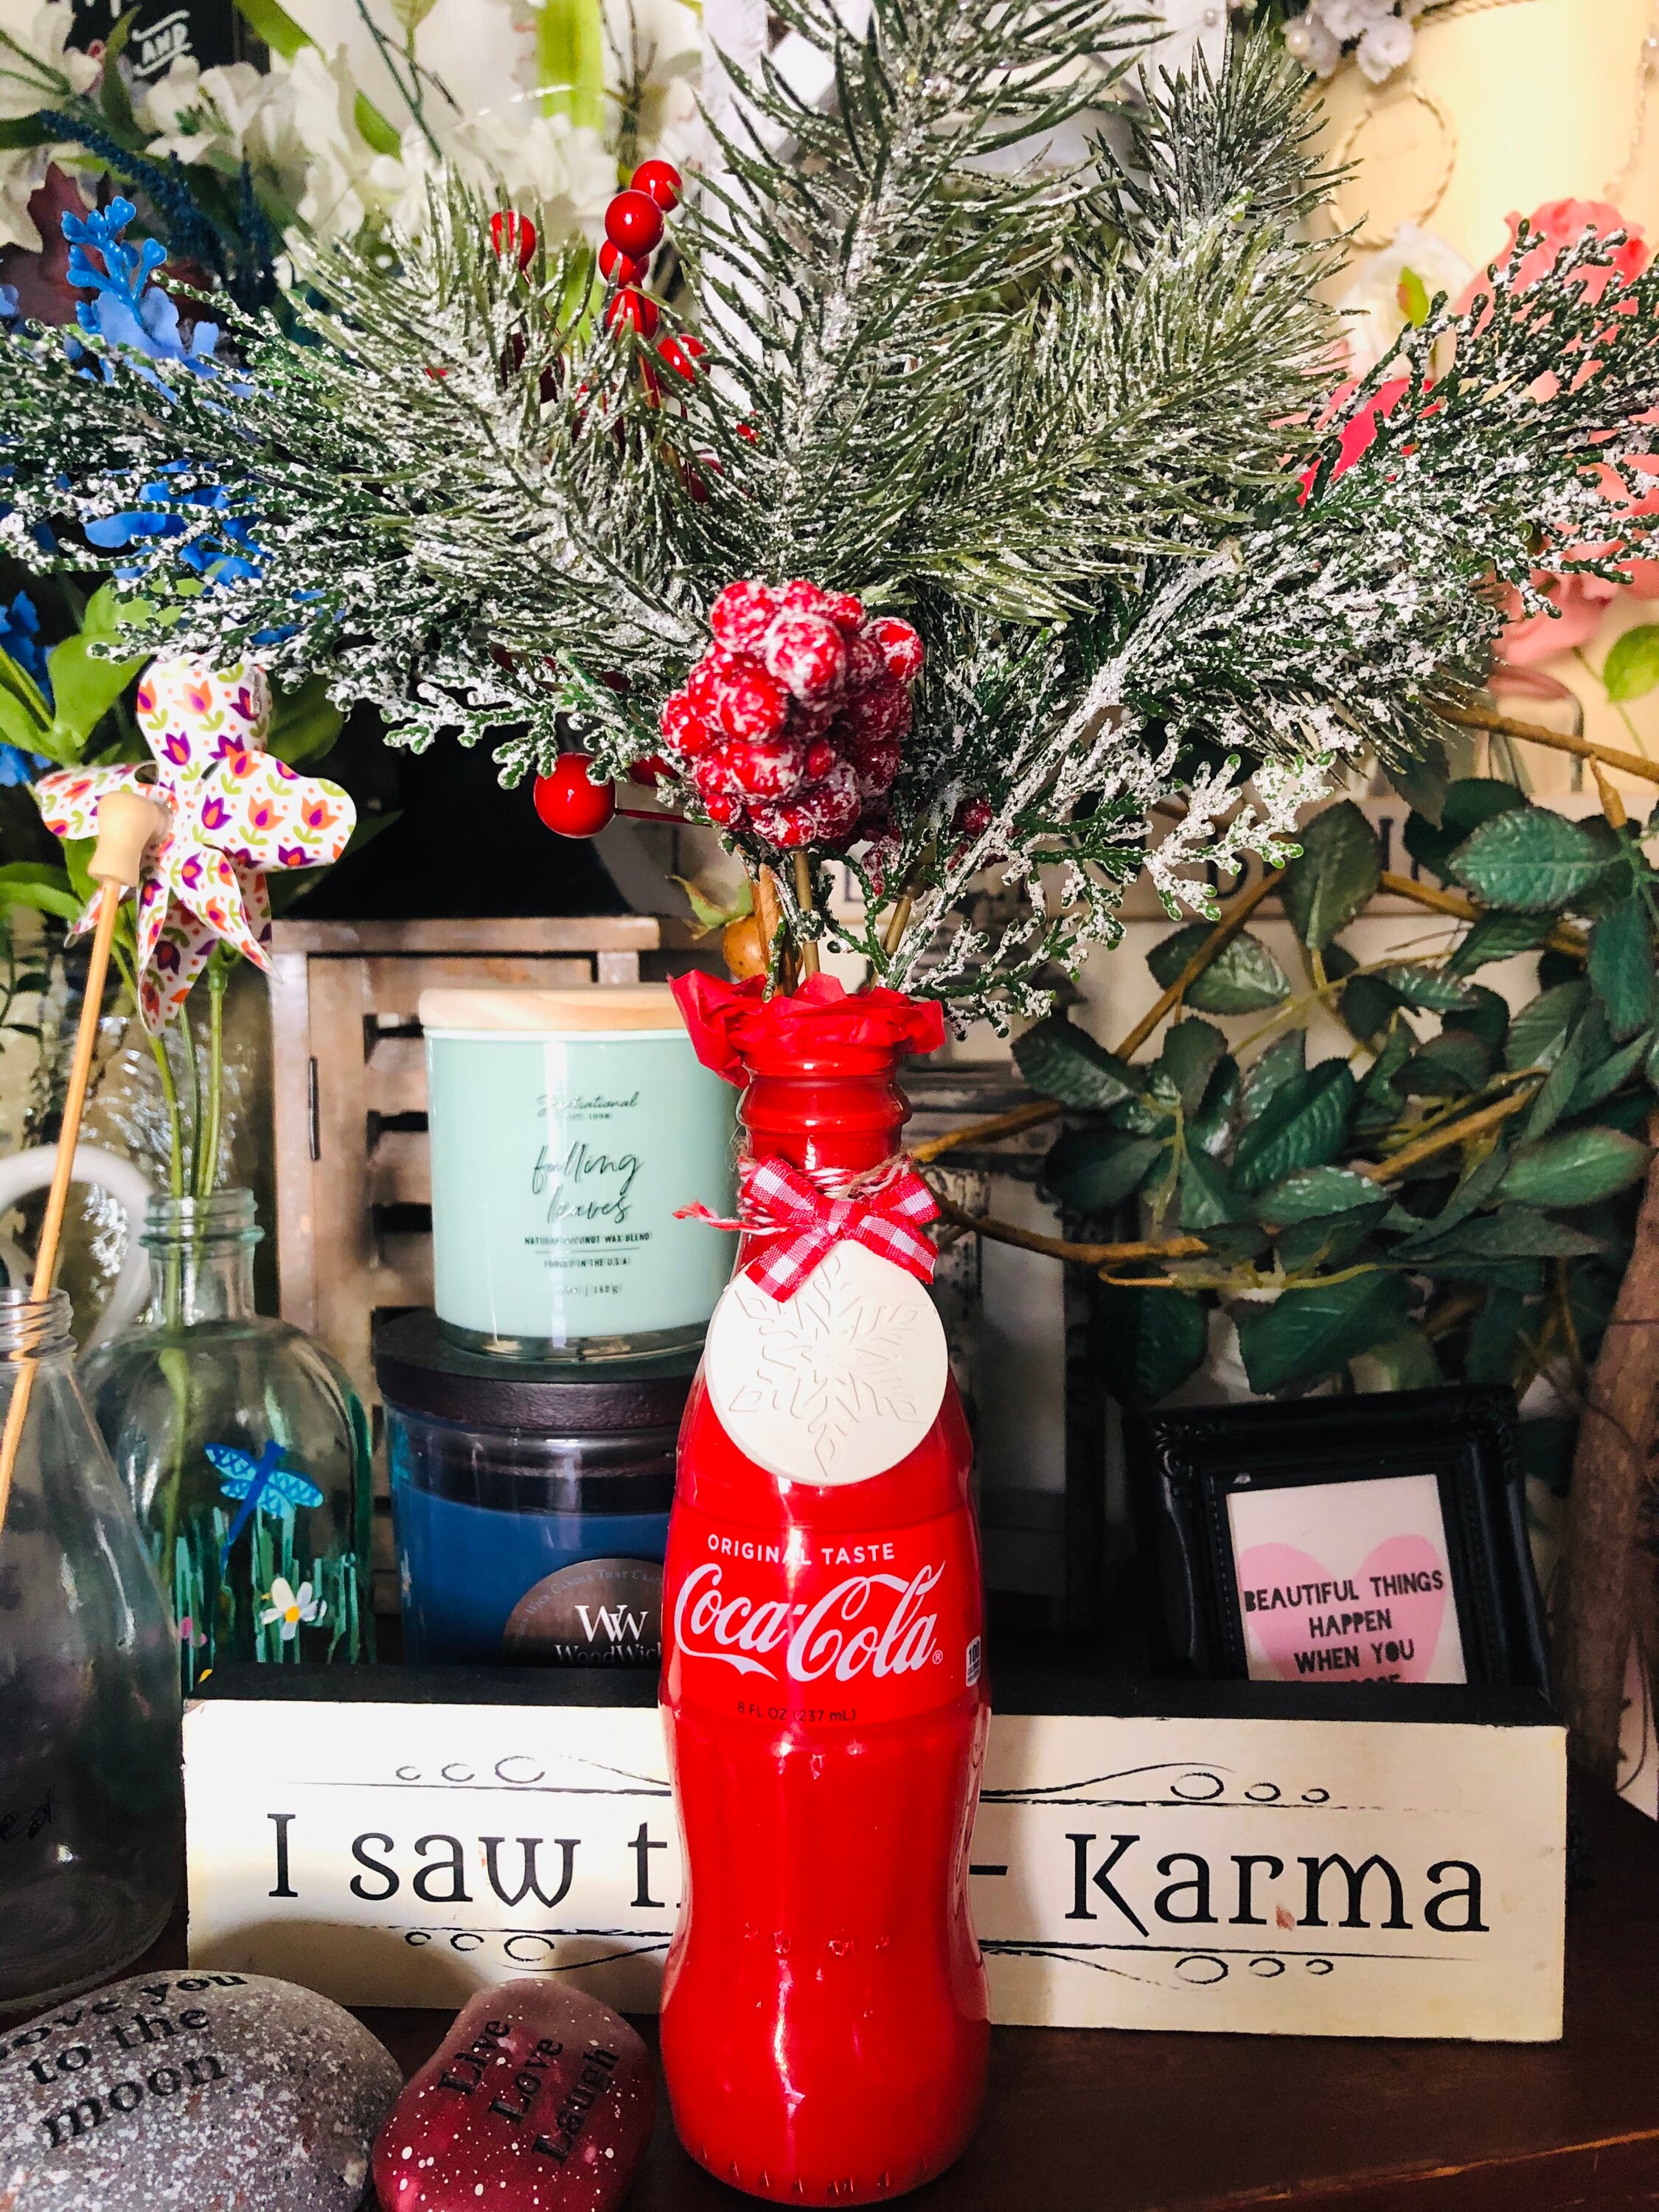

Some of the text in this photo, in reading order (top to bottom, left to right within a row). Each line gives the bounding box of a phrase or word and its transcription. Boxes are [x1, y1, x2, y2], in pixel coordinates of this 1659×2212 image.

[143, 23, 189, 65] AND
[532, 1141, 644, 1195] falling
[547, 1183, 633, 1224] leaves
[605, 1234, 622, 1243] WAX
[625, 1232, 650, 1242] BLEND
[578, 1259, 587, 1267] IN
[590, 1258, 604, 1267] THE
[707, 1533, 896, 1565] ORIGINAL TASTE
[1244, 1570, 1445, 1613] BEAUTIFUL THINGS
[674, 1560, 946, 1683] Coca-Cola
[1309, 1608, 1394, 1639] HAPPEN
[1293, 1638, 1415, 1674] WHEN YOU
[737, 1701, 857, 1722] 8 FL OZ (237 mL)
[268, 1813, 298, 1898] I
[349, 1832, 581, 1908] saw
[627, 1821, 683, 1908] t
[1064, 1833, 1490, 1938] Karma
[0, 1975, 248, 2060] ove you
[27, 2008, 211, 2085] to the
[437, 2020, 511, 2096] Live
[41, 2054, 229, 2148] moon
[487, 2038, 564, 2124] Love
[532, 2049, 621, 2167] Laugh
